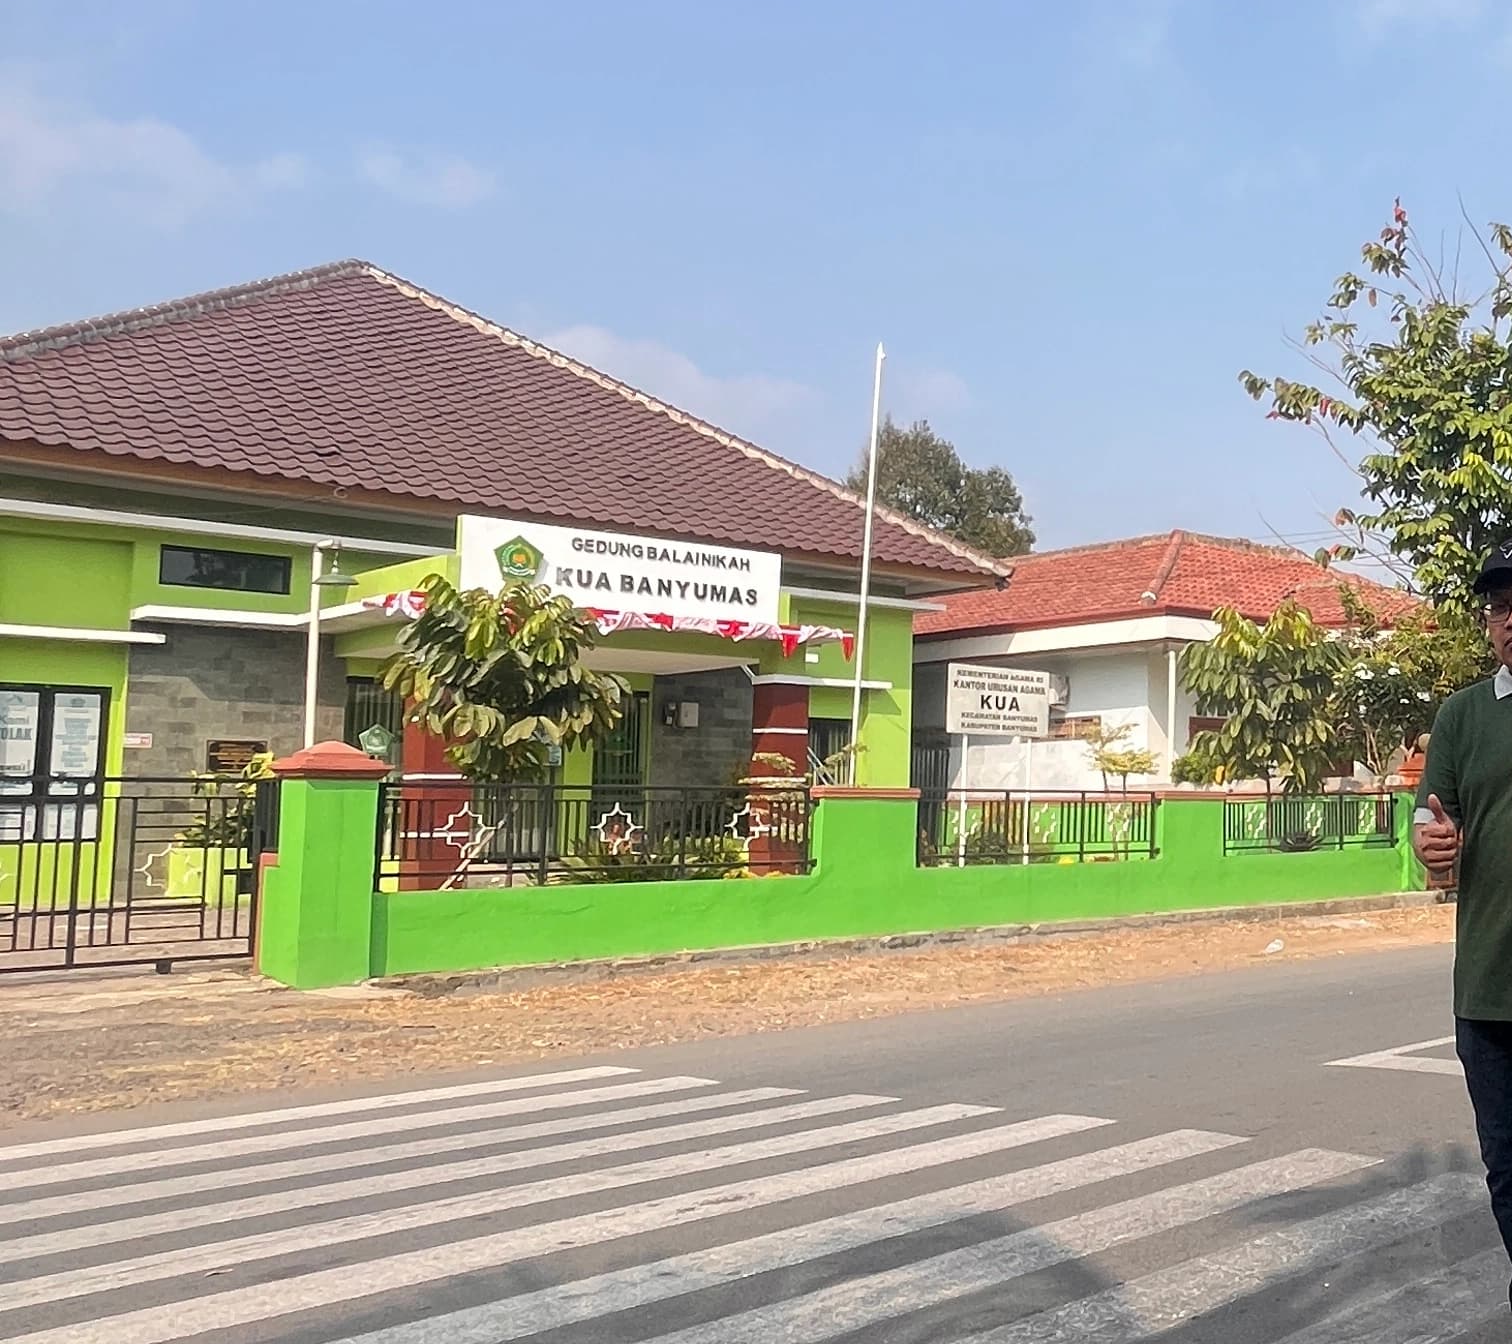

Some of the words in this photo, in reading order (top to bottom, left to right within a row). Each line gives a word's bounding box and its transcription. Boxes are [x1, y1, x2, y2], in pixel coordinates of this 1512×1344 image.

[556, 567, 612, 592] KUA
[620, 574, 758, 606] BANYUMAS
[953, 679, 986, 690] KANTOR
[987, 683, 1018, 693] URUSAN
[1020, 686, 1046, 695] AGAMA
[980, 695, 1020, 712] KUA
